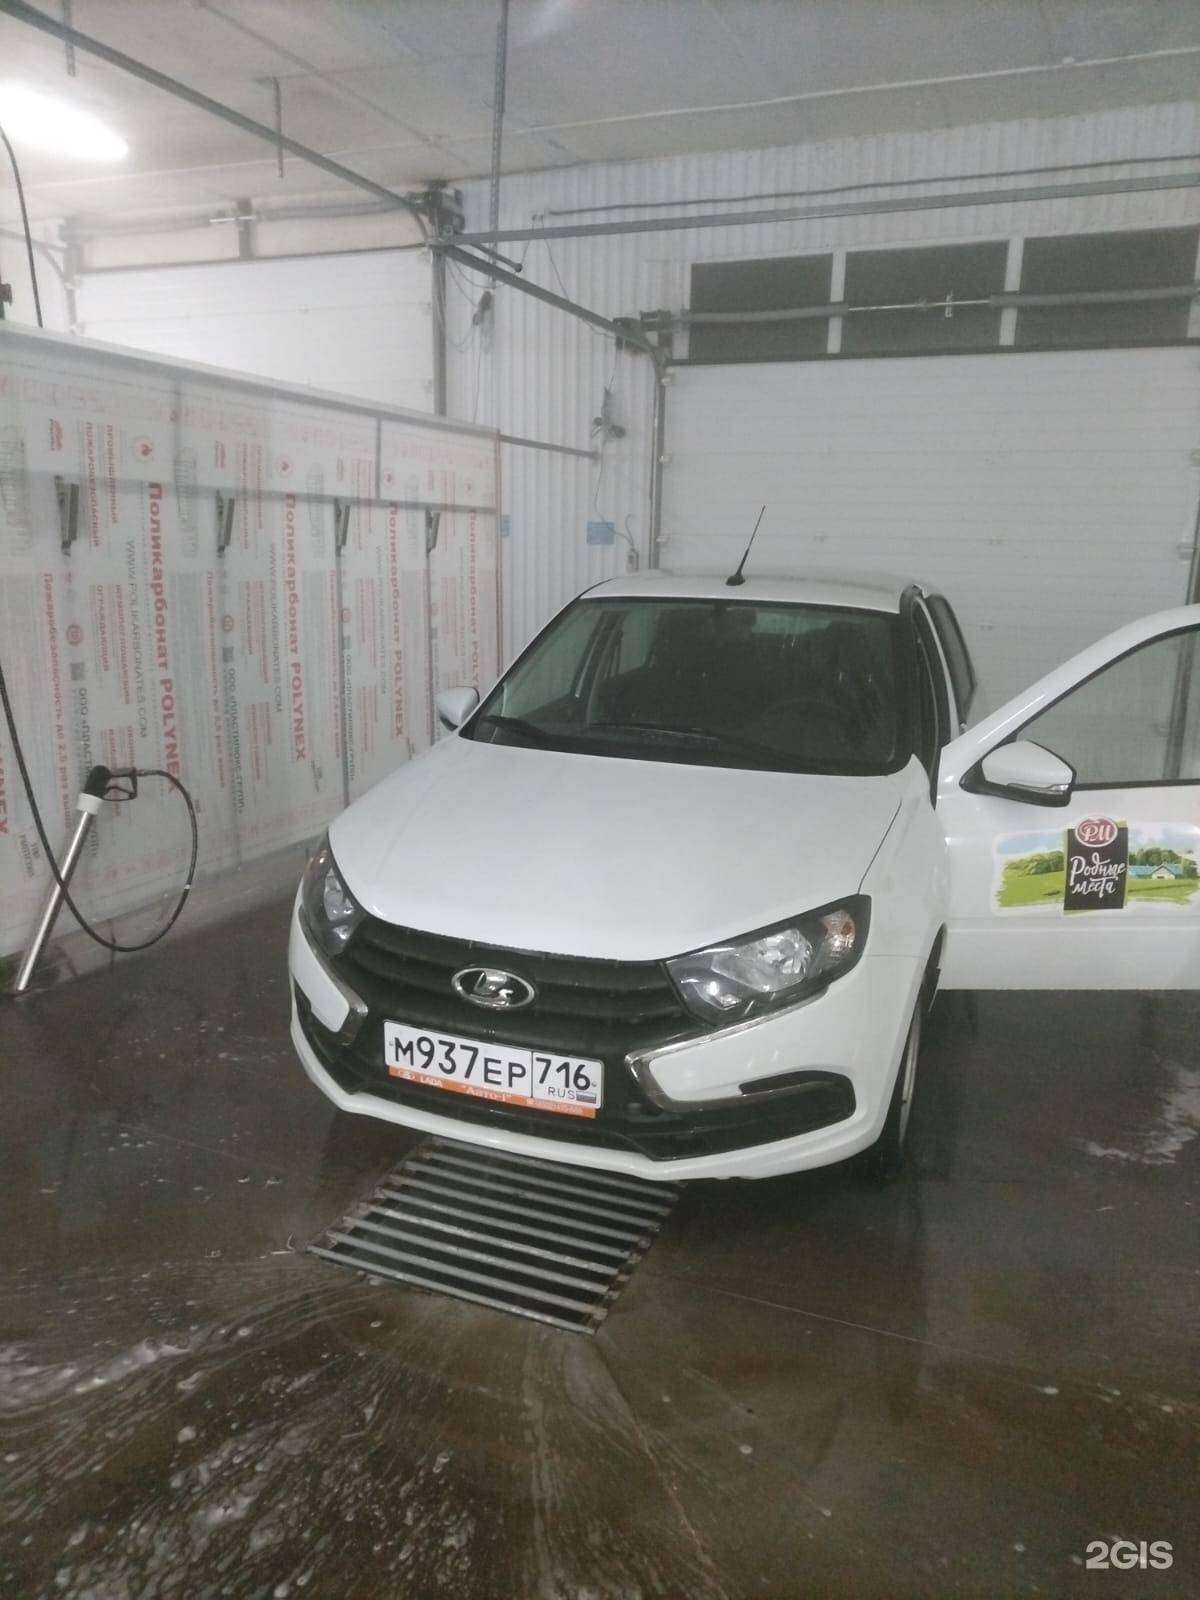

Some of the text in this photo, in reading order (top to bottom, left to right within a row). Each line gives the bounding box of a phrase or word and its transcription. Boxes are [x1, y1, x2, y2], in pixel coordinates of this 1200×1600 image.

[285, 493, 307, 762] Поликарбонат POLYNEX
[388, 502, 404, 738] Поликарбонат POLYNEX
[149, 481, 181, 794] Поликарбонат POLYNEX
[1069, 852, 1127, 886] Родные
[1071, 876, 1118, 898] места
[535, 1057, 591, 1091] 716
[548, 1086, 576, 1100] RUS
